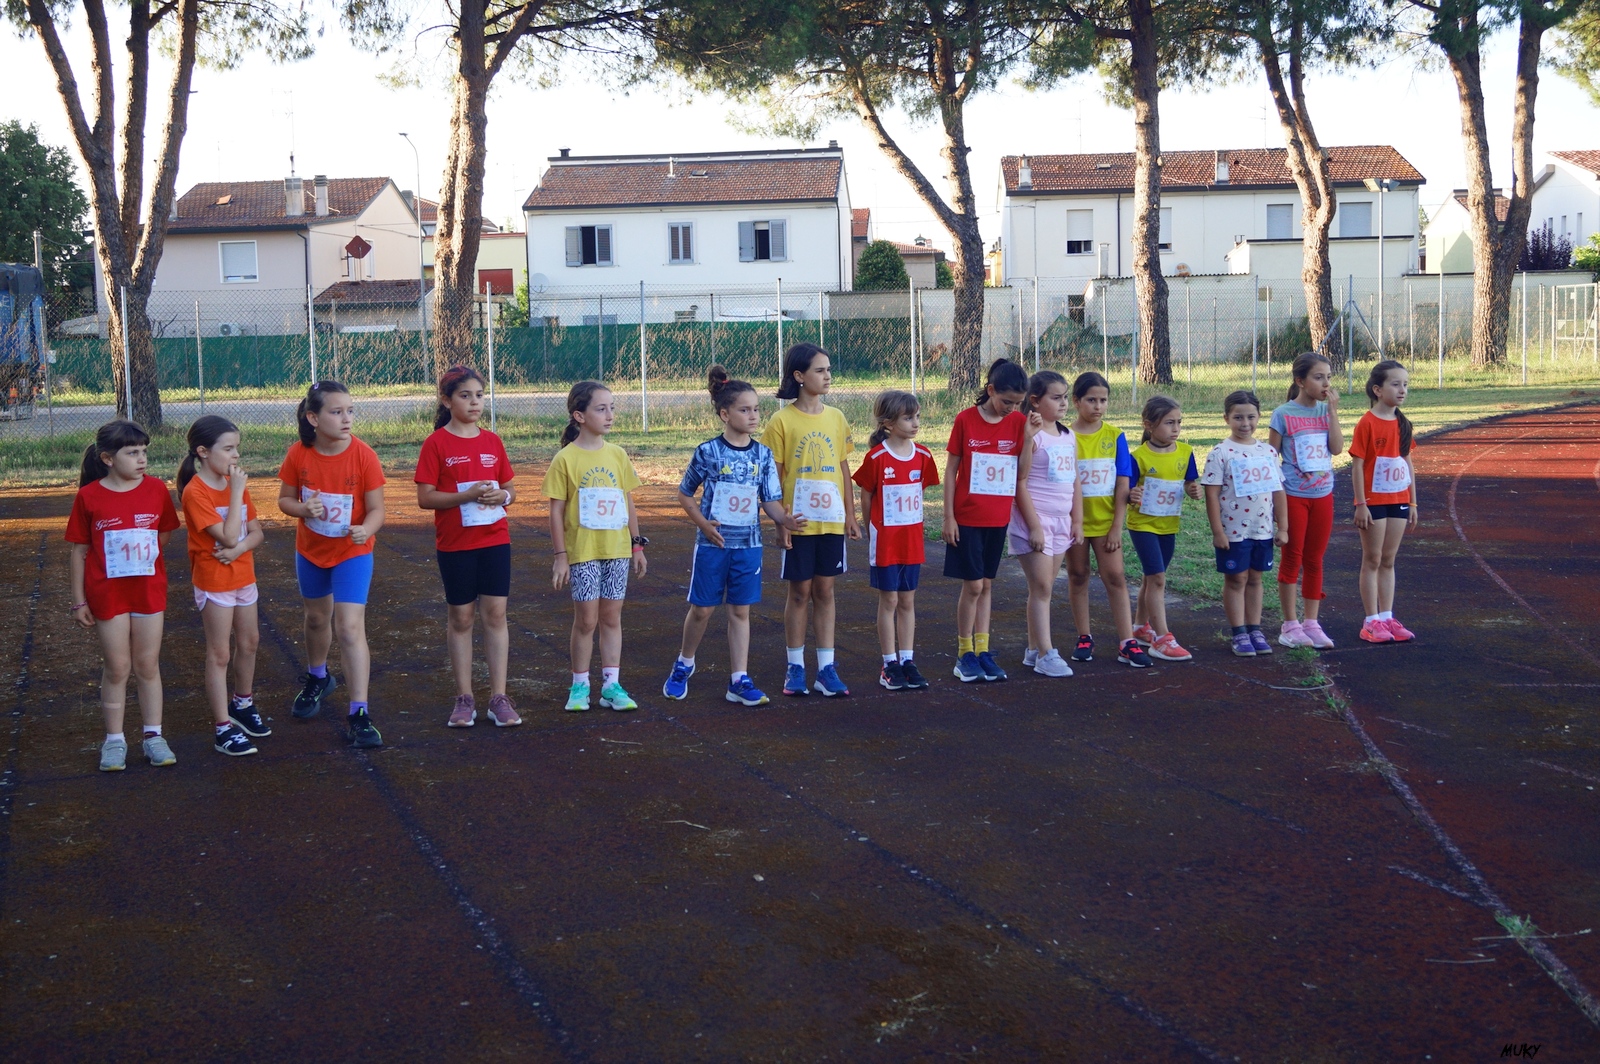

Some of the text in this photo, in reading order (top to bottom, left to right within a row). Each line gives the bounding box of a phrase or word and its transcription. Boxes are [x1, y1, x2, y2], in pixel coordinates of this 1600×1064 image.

[1284, 413, 1330, 436] LONSDAL
[986, 466, 1005, 482] 91
[1080, 469, 1109, 485] 257
[1241, 465, 1272, 484] 292
[1383, 466, 1405, 482] 108
[728, 495, 751, 513] 92
[809, 492, 832, 509] 59
[895, 495, 920, 512] 116
[1156, 491, 1176, 505] 55
[597, 499, 617, 516] 57
[121, 542, 151, 561] 111
